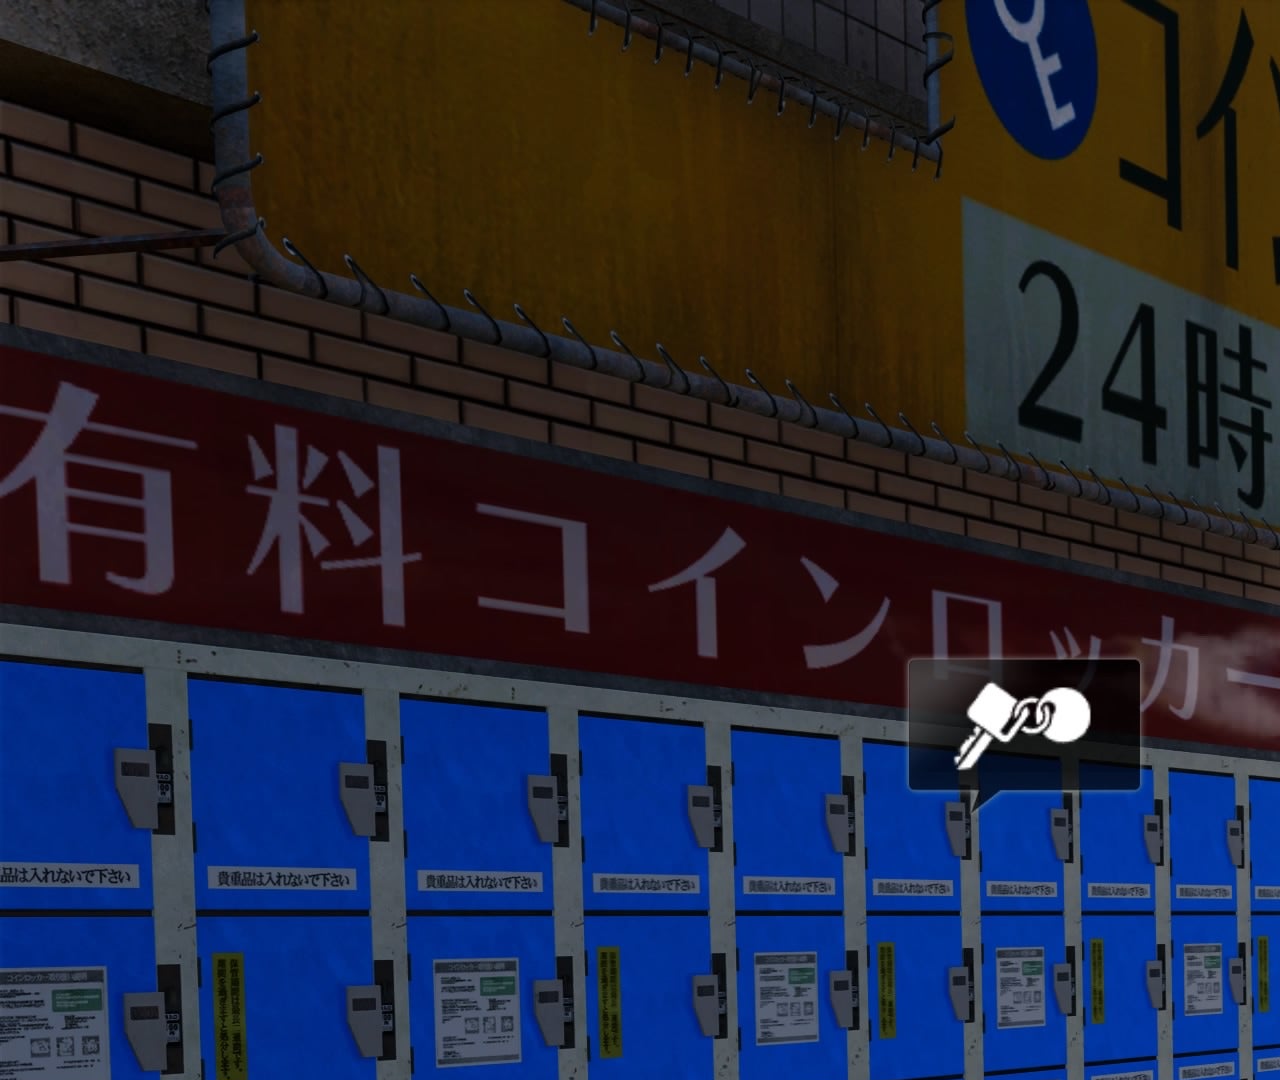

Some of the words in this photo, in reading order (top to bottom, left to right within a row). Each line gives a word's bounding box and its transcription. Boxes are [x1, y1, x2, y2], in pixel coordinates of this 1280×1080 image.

[218, 870, 350, 888] 貴重品は入れないで下さい
[426, 873, 538, 890] 貴重品は入れないで下さい
